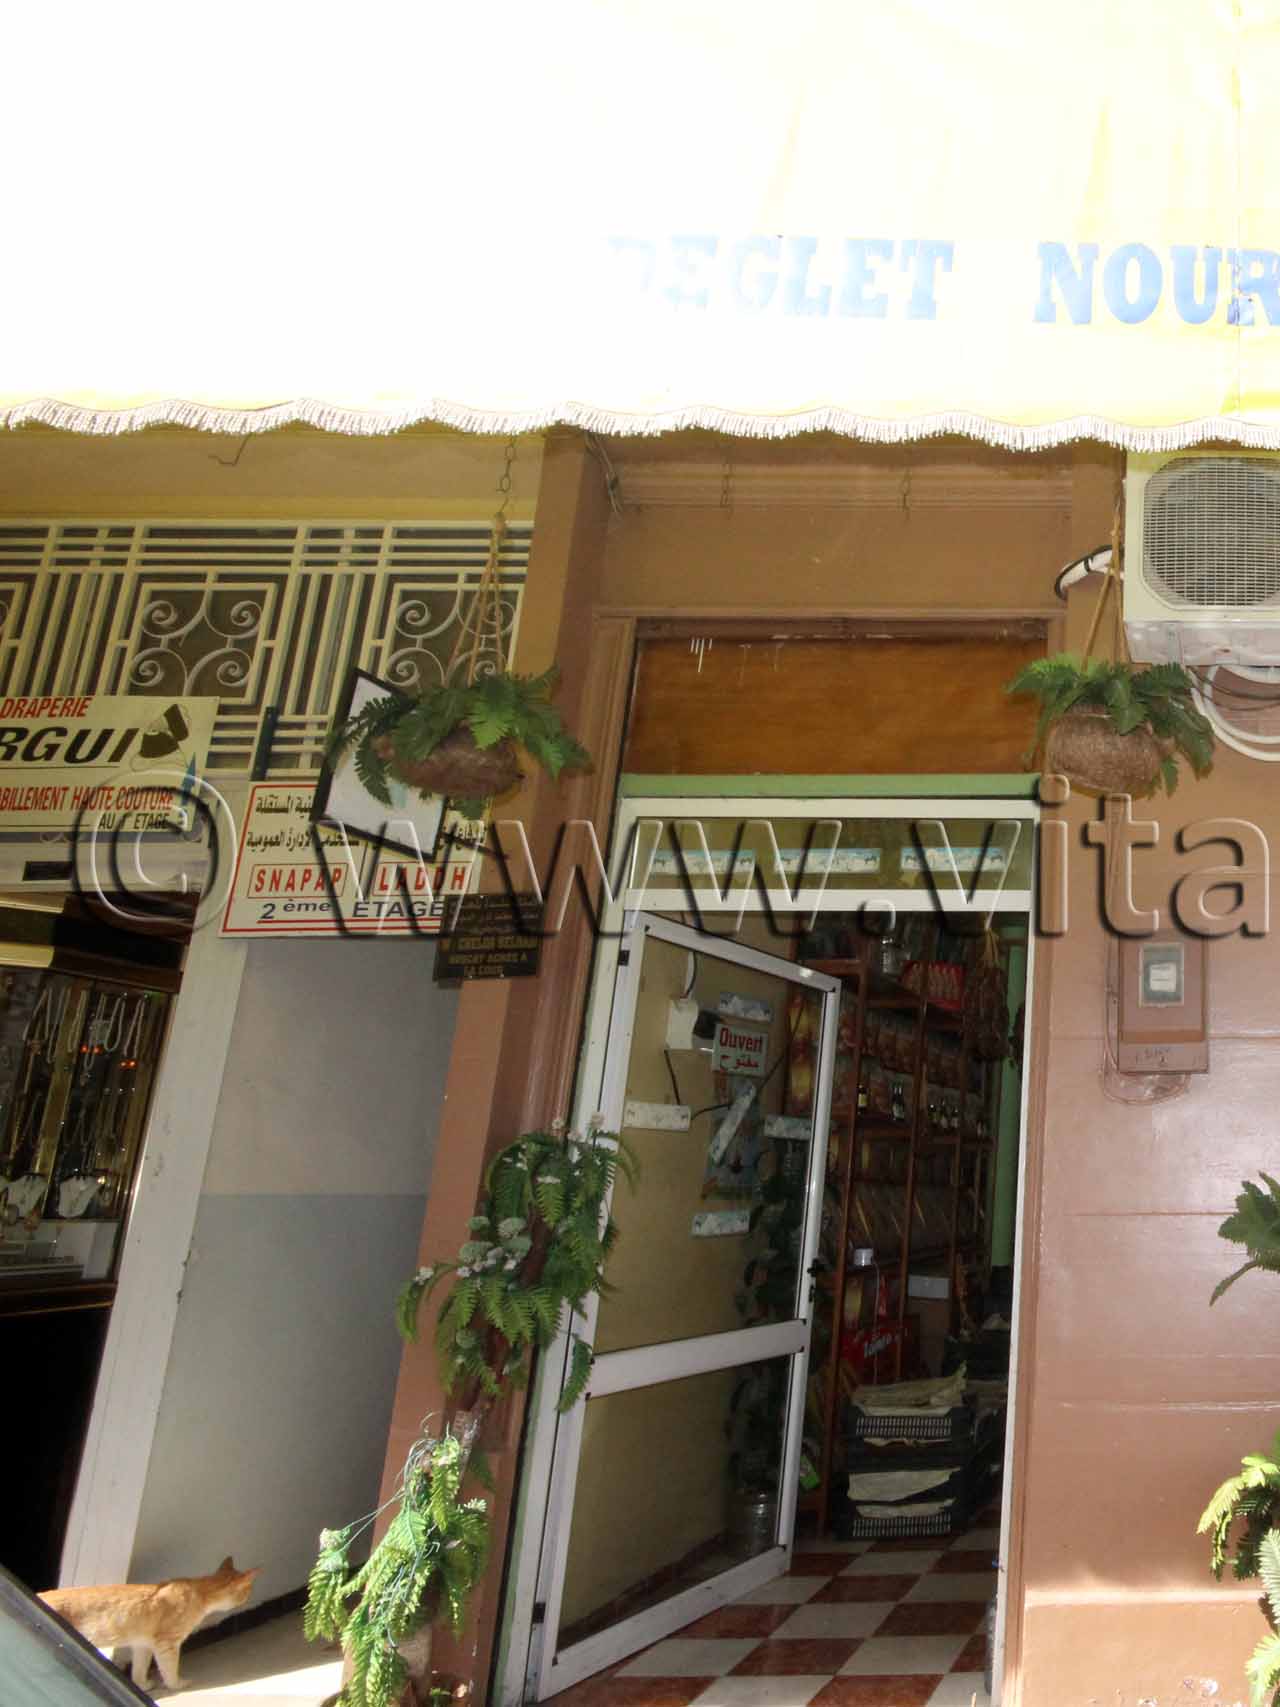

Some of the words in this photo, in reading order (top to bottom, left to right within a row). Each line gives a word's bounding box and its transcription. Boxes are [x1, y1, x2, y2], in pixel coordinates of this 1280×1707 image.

[0, 786, 69, 811] BILLEMENT
[71, 786, 116, 811] HAUTE
[116, 786, 175, 811] COUTURE
[255, 867, 342, 893] SNAPAP
[719, 1027, 763, 1053] Ouvert
